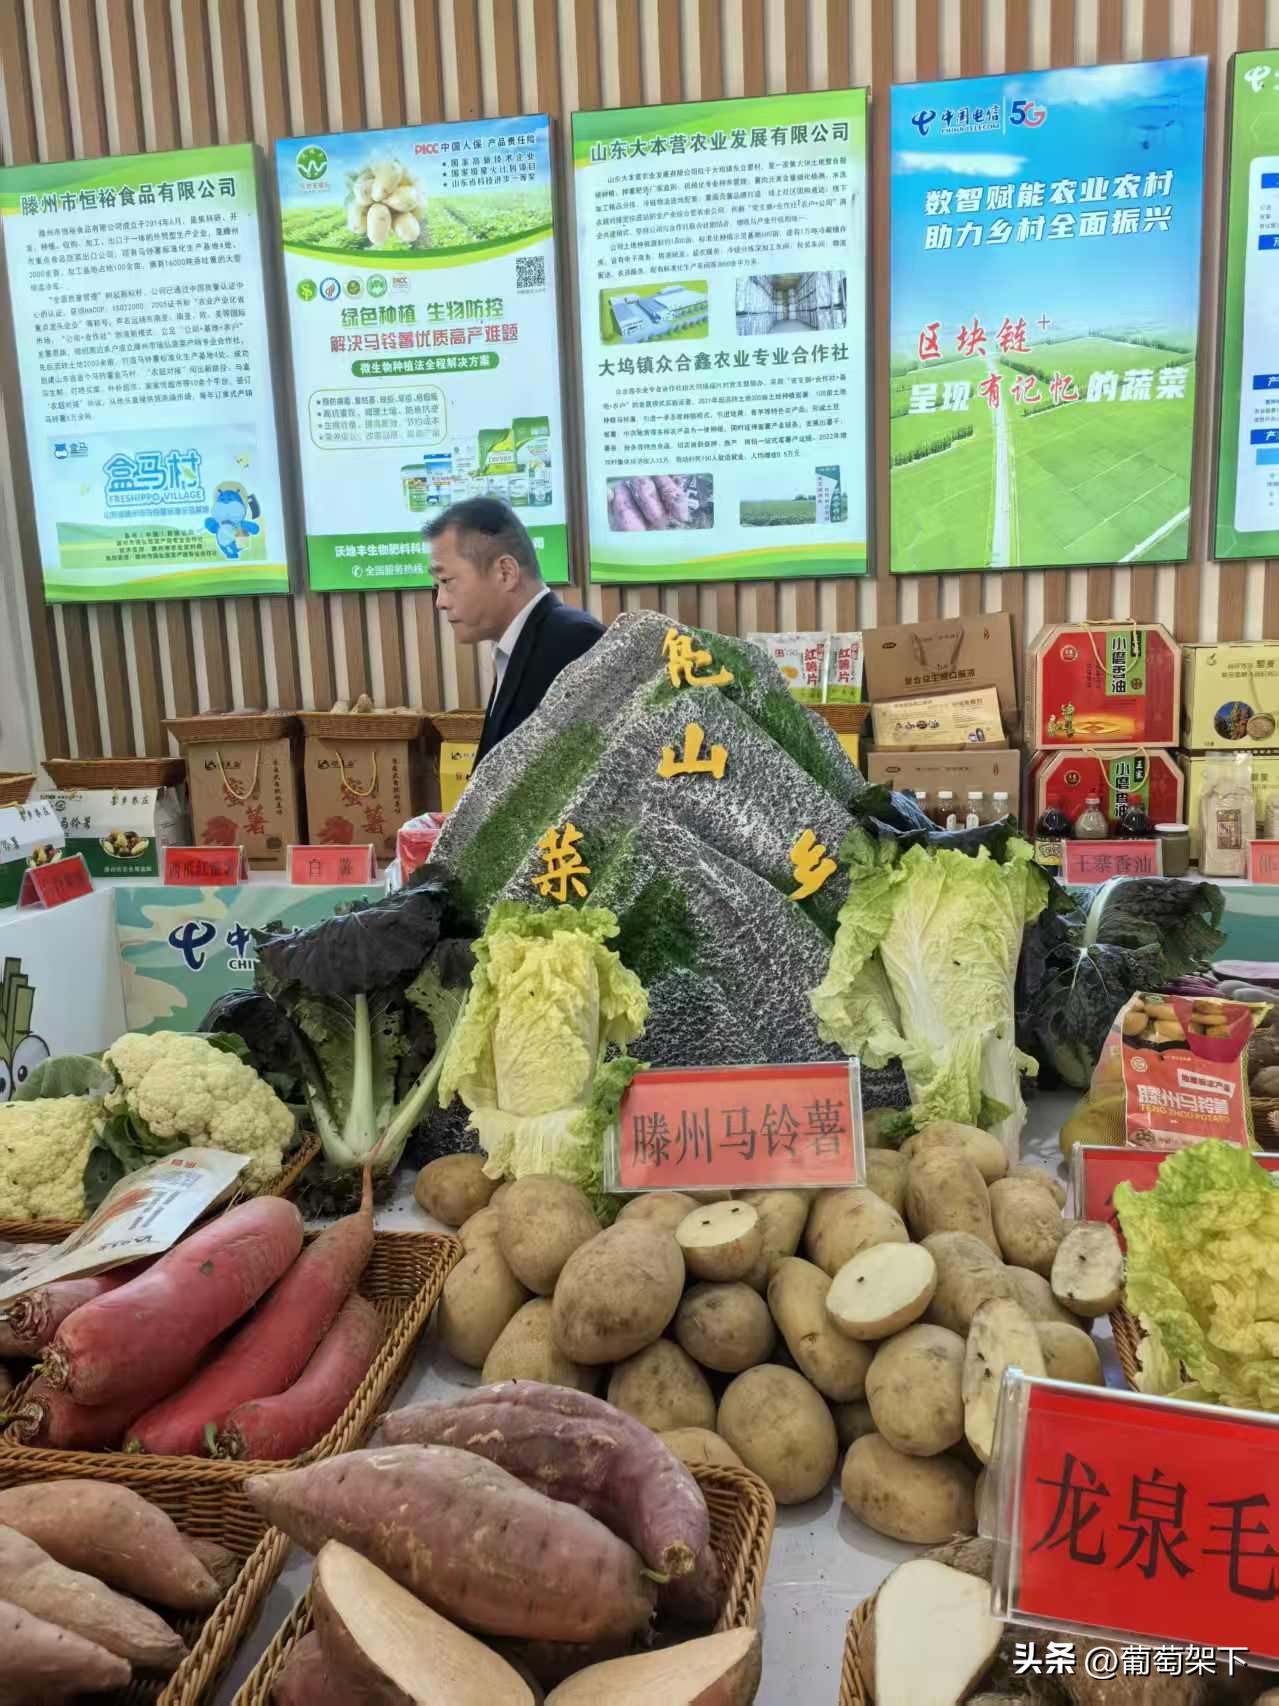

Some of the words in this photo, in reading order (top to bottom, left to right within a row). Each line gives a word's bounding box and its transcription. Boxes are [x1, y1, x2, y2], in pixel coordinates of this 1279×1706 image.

[942, 105, 999, 126] 中国电信
[1010, 100, 1046, 128] 5G
[441, 138, 482, 153] 中国人保
[591, 122, 849, 162] 山东大本营农业发展有限公司
[22, 177, 237, 216] 滕州市恒裕食品有限公司
[924, 169, 1174, 217] 数智赋能农业农村
[924, 206, 1173, 250] 助力乡村全面振兴
[341, 304, 417, 328] 绿色种植
[427, 297, 504, 323] 生物防控
[330, 322, 520, 353] 解决马铃薯优质高产难题
[598, 343, 850, 377] 大坞镇众合鑫农业专业合作社
[908, 366, 1189, 416] 呈现有记忆的蔬菜
[107, 453, 199, 493] 盒马村
[657, 722, 729, 780] 山
[531, 822, 592, 902] 菜
[790, 828, 838, 901] 乡
[631, 1098, 847, 1168] 滕州马铃薯
[1028, 1452, 1279, 1603] 龙泉毛
